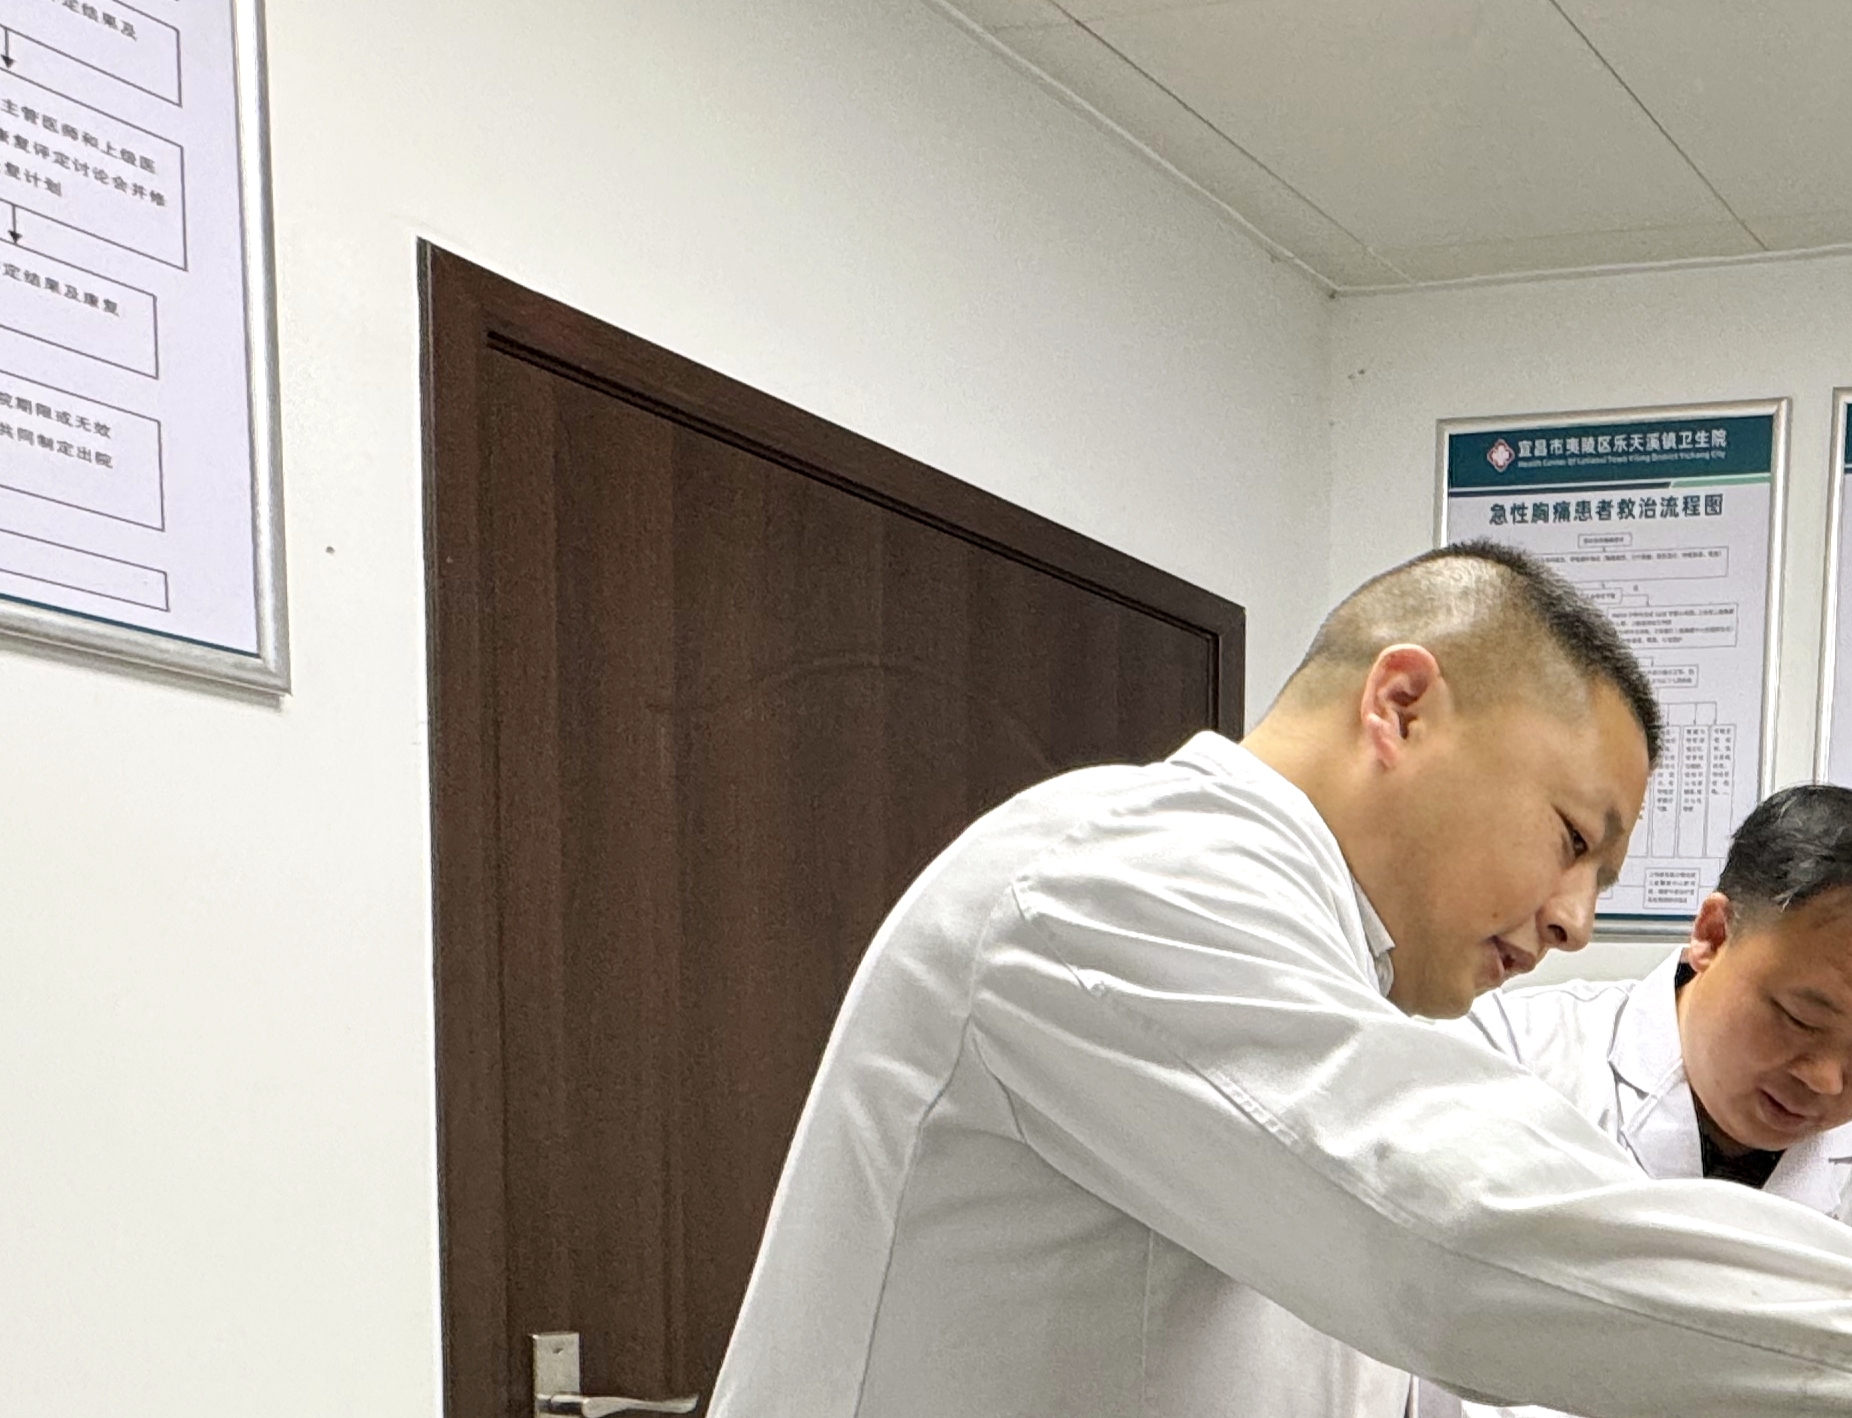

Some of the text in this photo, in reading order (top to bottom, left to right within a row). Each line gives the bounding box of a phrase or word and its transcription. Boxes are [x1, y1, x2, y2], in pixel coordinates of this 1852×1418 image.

[54, 0, 137, 42] 定结果及
[0, 161, 62, 197] 复计划
[0, 261, 120, 317] 定结果及康复
[1518, 429, 1728, 458] 宜昌市夷陵区乐天溪镇卫生院
[1489, 493, 1724, 526] 急性胸痛患者救治流程图
